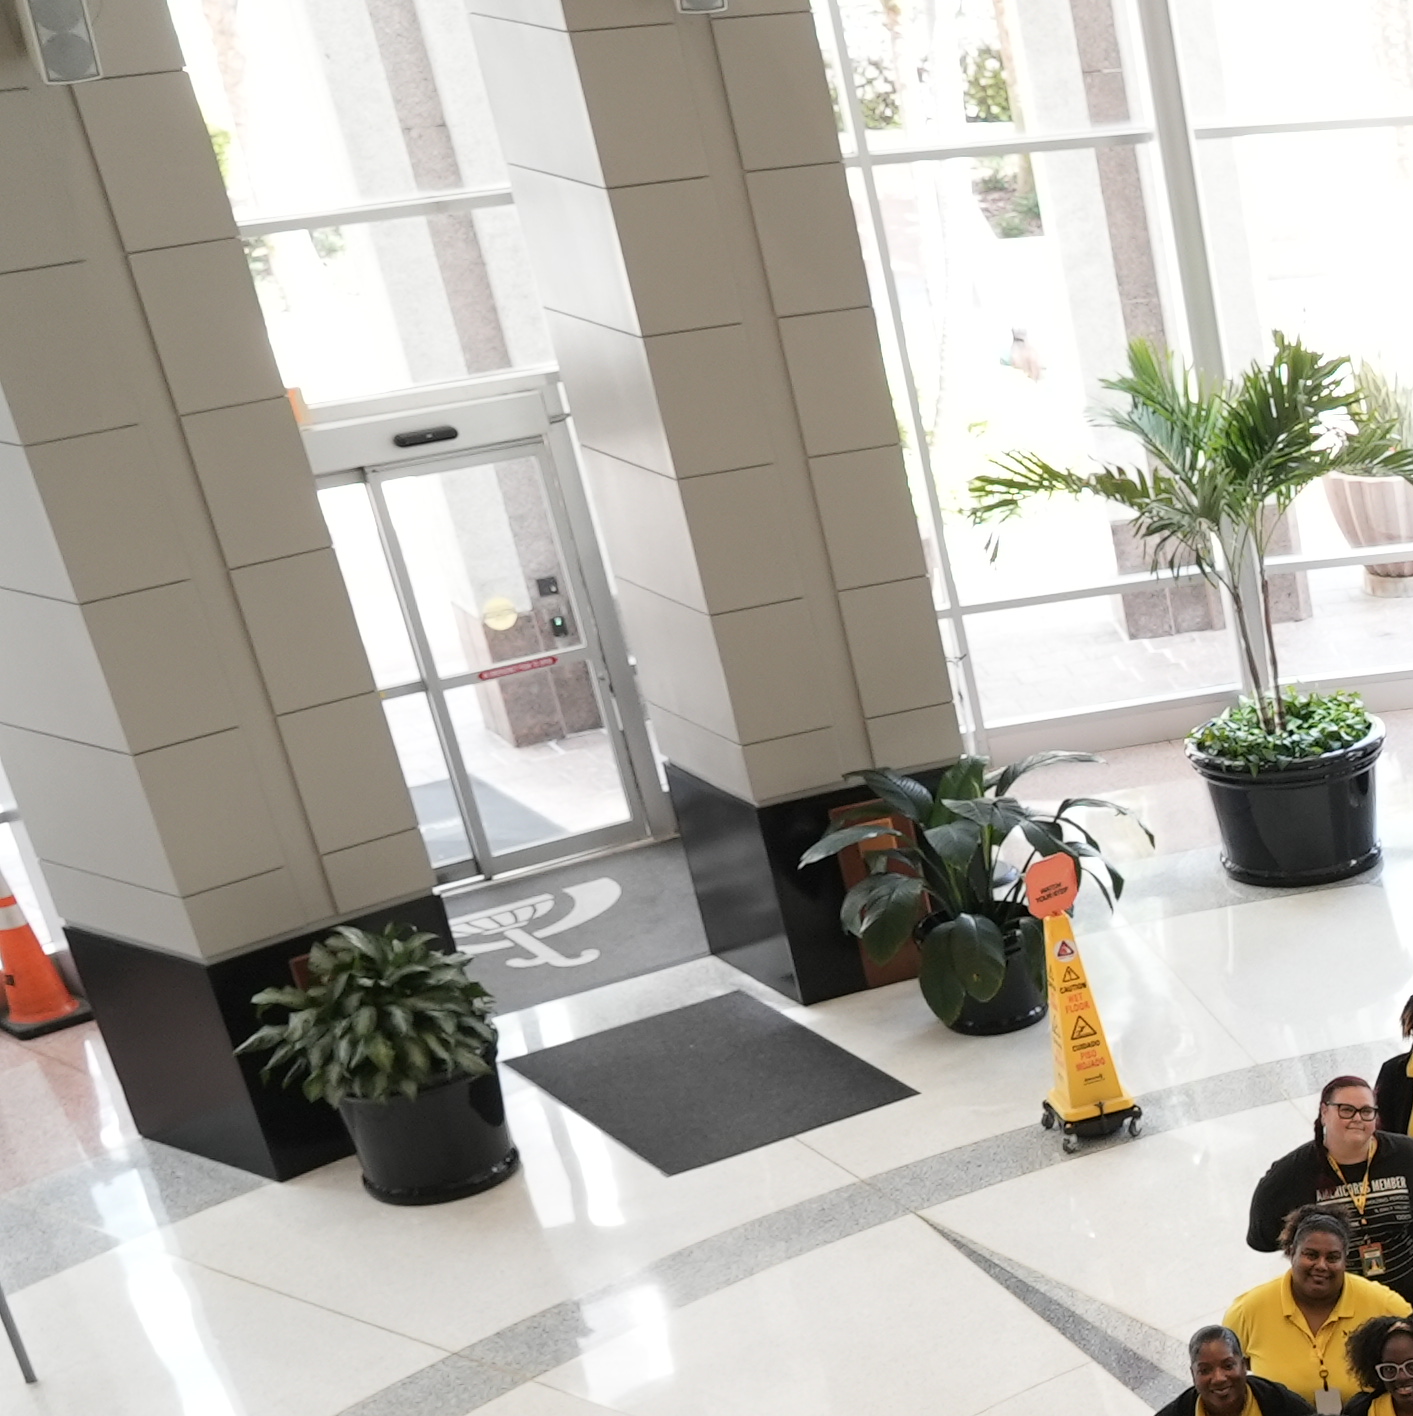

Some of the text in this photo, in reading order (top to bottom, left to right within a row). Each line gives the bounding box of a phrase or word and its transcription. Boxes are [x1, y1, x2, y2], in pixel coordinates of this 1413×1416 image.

[1060, 982, 1087, 994] CAUTION
[1065, 1001, 1091, 1014] FLOOR
[1371, 1175, 1407, 1192] MEMBER
